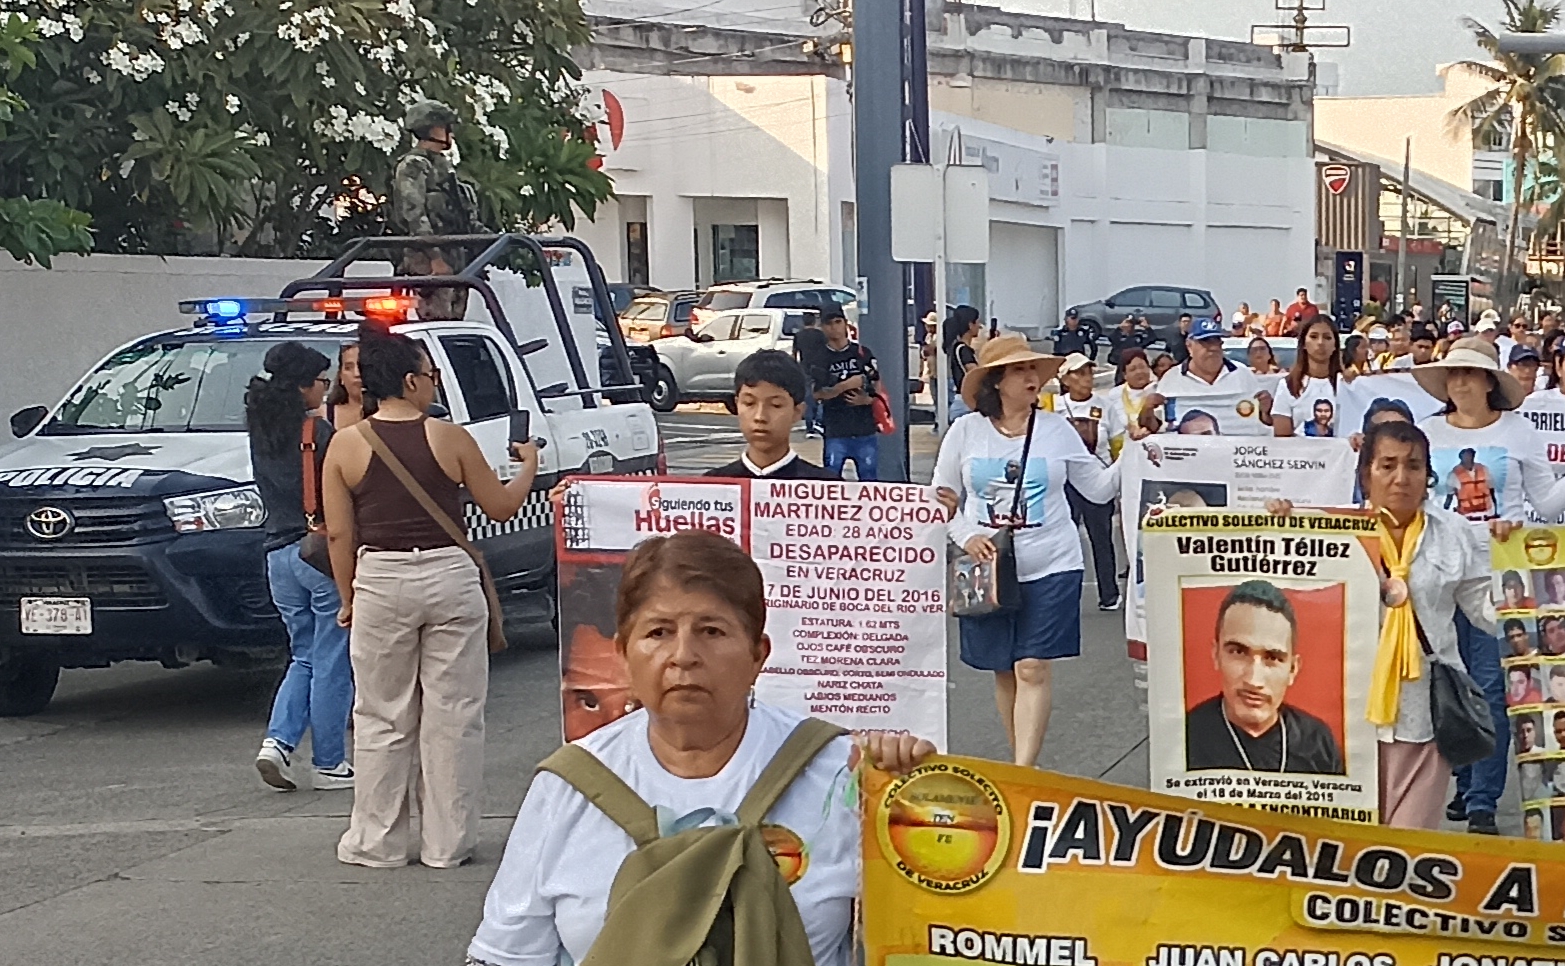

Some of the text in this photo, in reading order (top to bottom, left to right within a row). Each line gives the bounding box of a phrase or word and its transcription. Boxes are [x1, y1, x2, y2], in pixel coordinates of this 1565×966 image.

[1514, 411, 1565, 432] BRIEL
[1233, 446, 1269, 457] JORGE
[1233, 457, 1285, 469] SÁNCHEZ
[770, 483, 930, 503] MIGUEL ANGEL
[713, 499, 734, 512] tus
[754, 503, 946, 523] MARTINEZ OCHOA
[634, 509, 736, 535] Huellas
[1222, 515, 1285, 528] SOLECITO
[1290, 515, 1305, 529] DE
[1308, 516, 1378, 531] VERACRUZ
[842, 525, 861, 539] 28
[770, 542, 936, 564] DESAPARECIDO
[1177, 534, 1351, 559] Valentín Téllez
[1210, 553, 1317, 577] Gutiérrez
[786, 565, 906, 583] EN VERACRUZ
[767, 584, 941, 603] 7 DE JUNIO DEL 2016
[764, 600, 819, 610] RIGINARIO
[822, 602, 836, 611] DE
[839, 602, 870, 612] BOCA
[873, 603, 894, 613] DEL
[862, 632, 909, 642] DELGADA
[796, 642, 824, 652] OJOS
[825, 642, 851, 652] CAFÉ
[801, 655, 901, 666] TEZ MORENA CLARA
[760, 667, 796, 676] ABELLO
[817, 680, 884, 690] NARIZ CHATA
[804, 692, 897, 702] LABIOS MEDIANOS
[810, 703, 891, 714] MENTÓN RECTO
[884, 764, 1003, 815] COLECTIVO SOLECITO
[1165, 778, 1180, 788] Se
[1236, 778, 1250, 786] en
[1312, 780, 1363, 792] Veracruz
[1196, 788, 1334, 802] el 18 de Marzo del 2015
[896, 860, 989, 891] DE VERACRUZ
[1482, 863, 1538, 918] A
[1306, 895, 1536, 940] COLECTIVO
